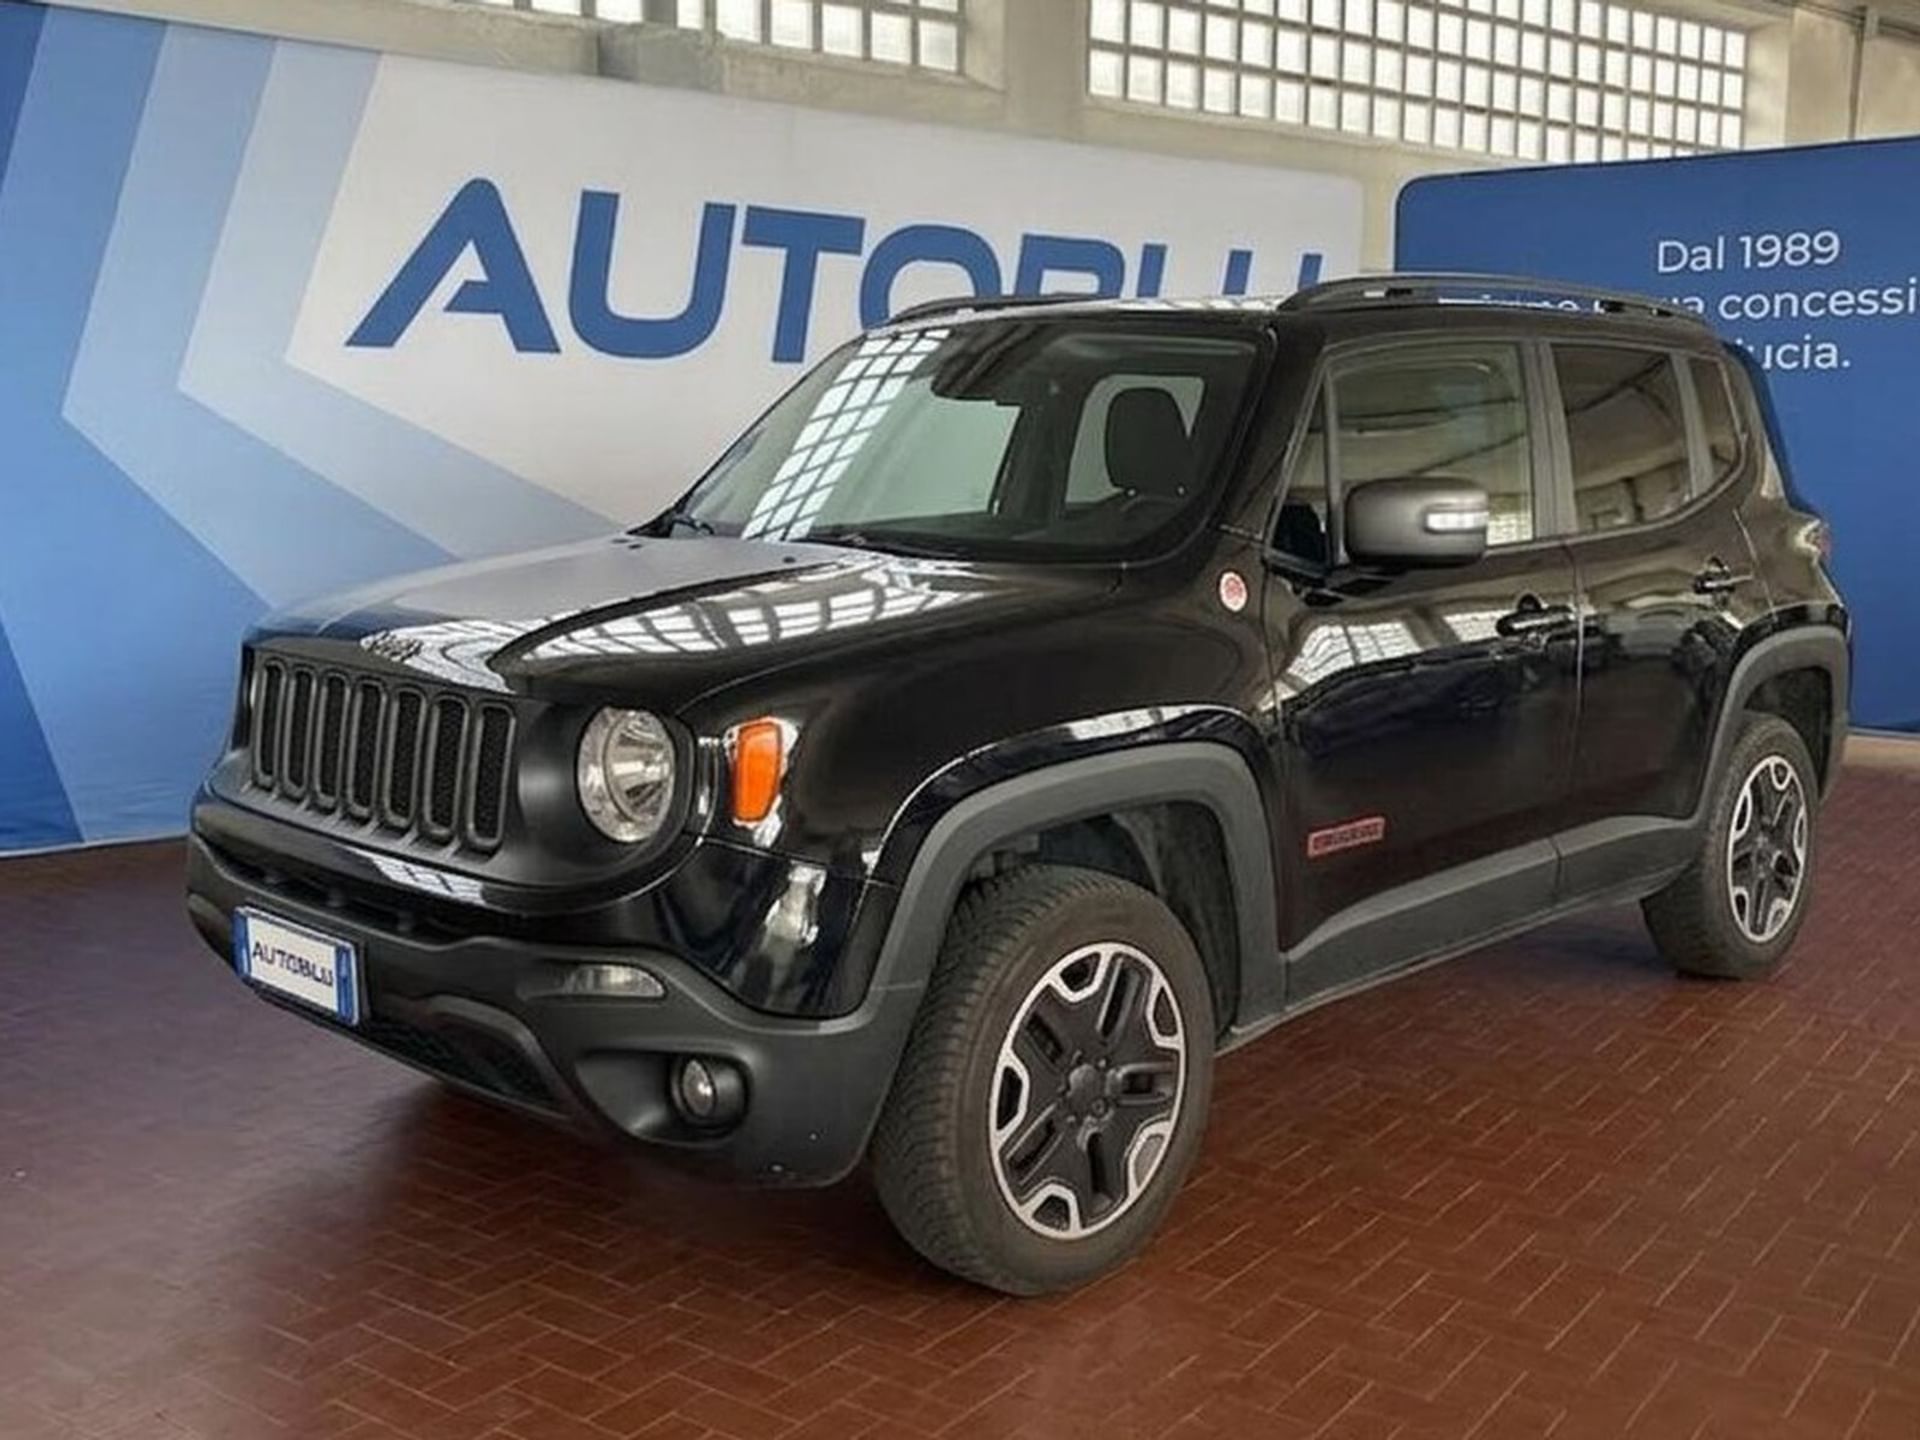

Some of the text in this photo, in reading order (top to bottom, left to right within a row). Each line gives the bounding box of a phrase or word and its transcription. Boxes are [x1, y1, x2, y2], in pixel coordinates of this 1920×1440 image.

[1657, 230, 1840, 273] Dal 1989
[252, 941, 333, 987] AUTOBLU
